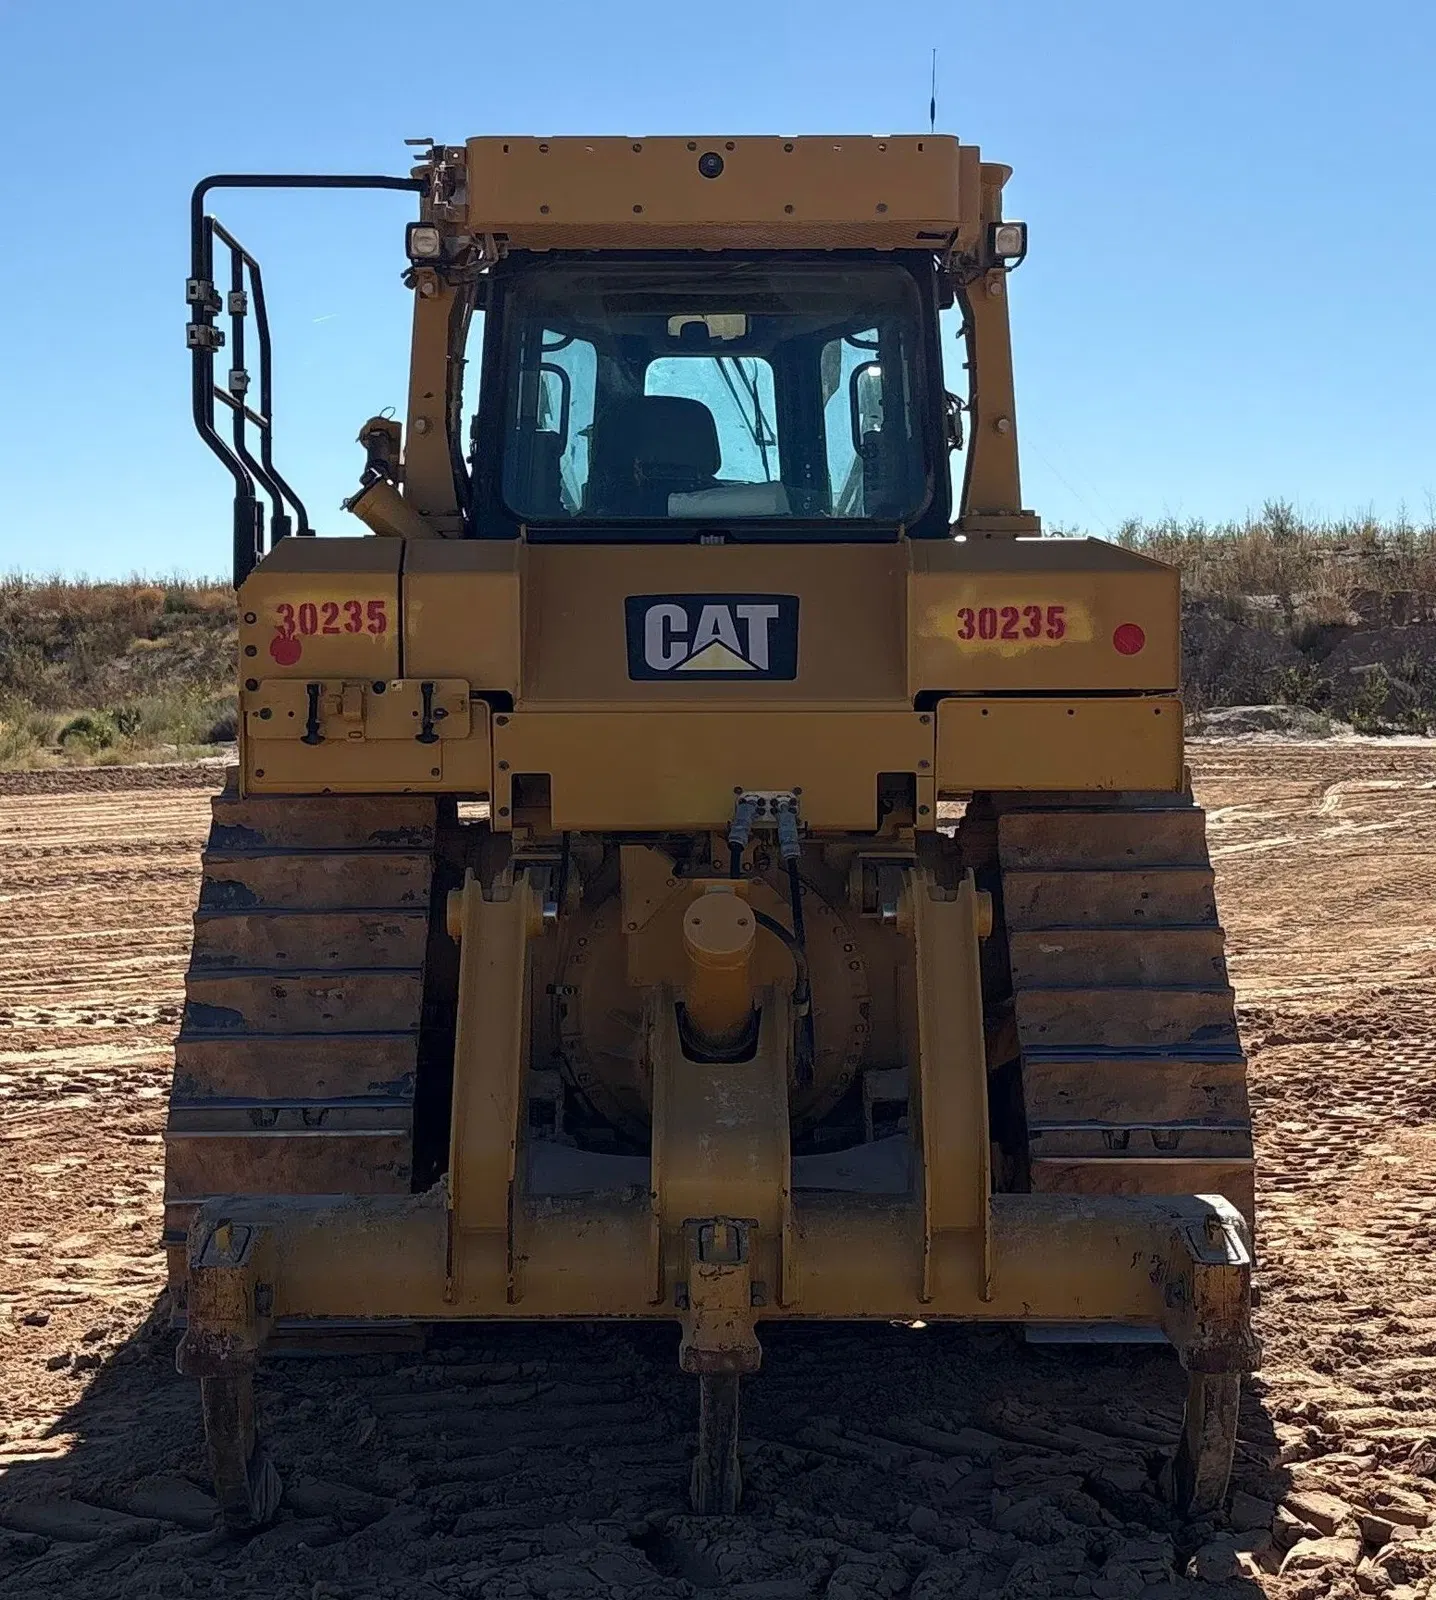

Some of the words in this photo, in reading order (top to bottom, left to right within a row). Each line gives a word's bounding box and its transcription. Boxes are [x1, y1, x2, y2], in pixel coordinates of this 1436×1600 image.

[276, 601, 387, 635] 30235
[957, 606, 1065, 640] 30235
[645, 604, 779, 670] CAT
